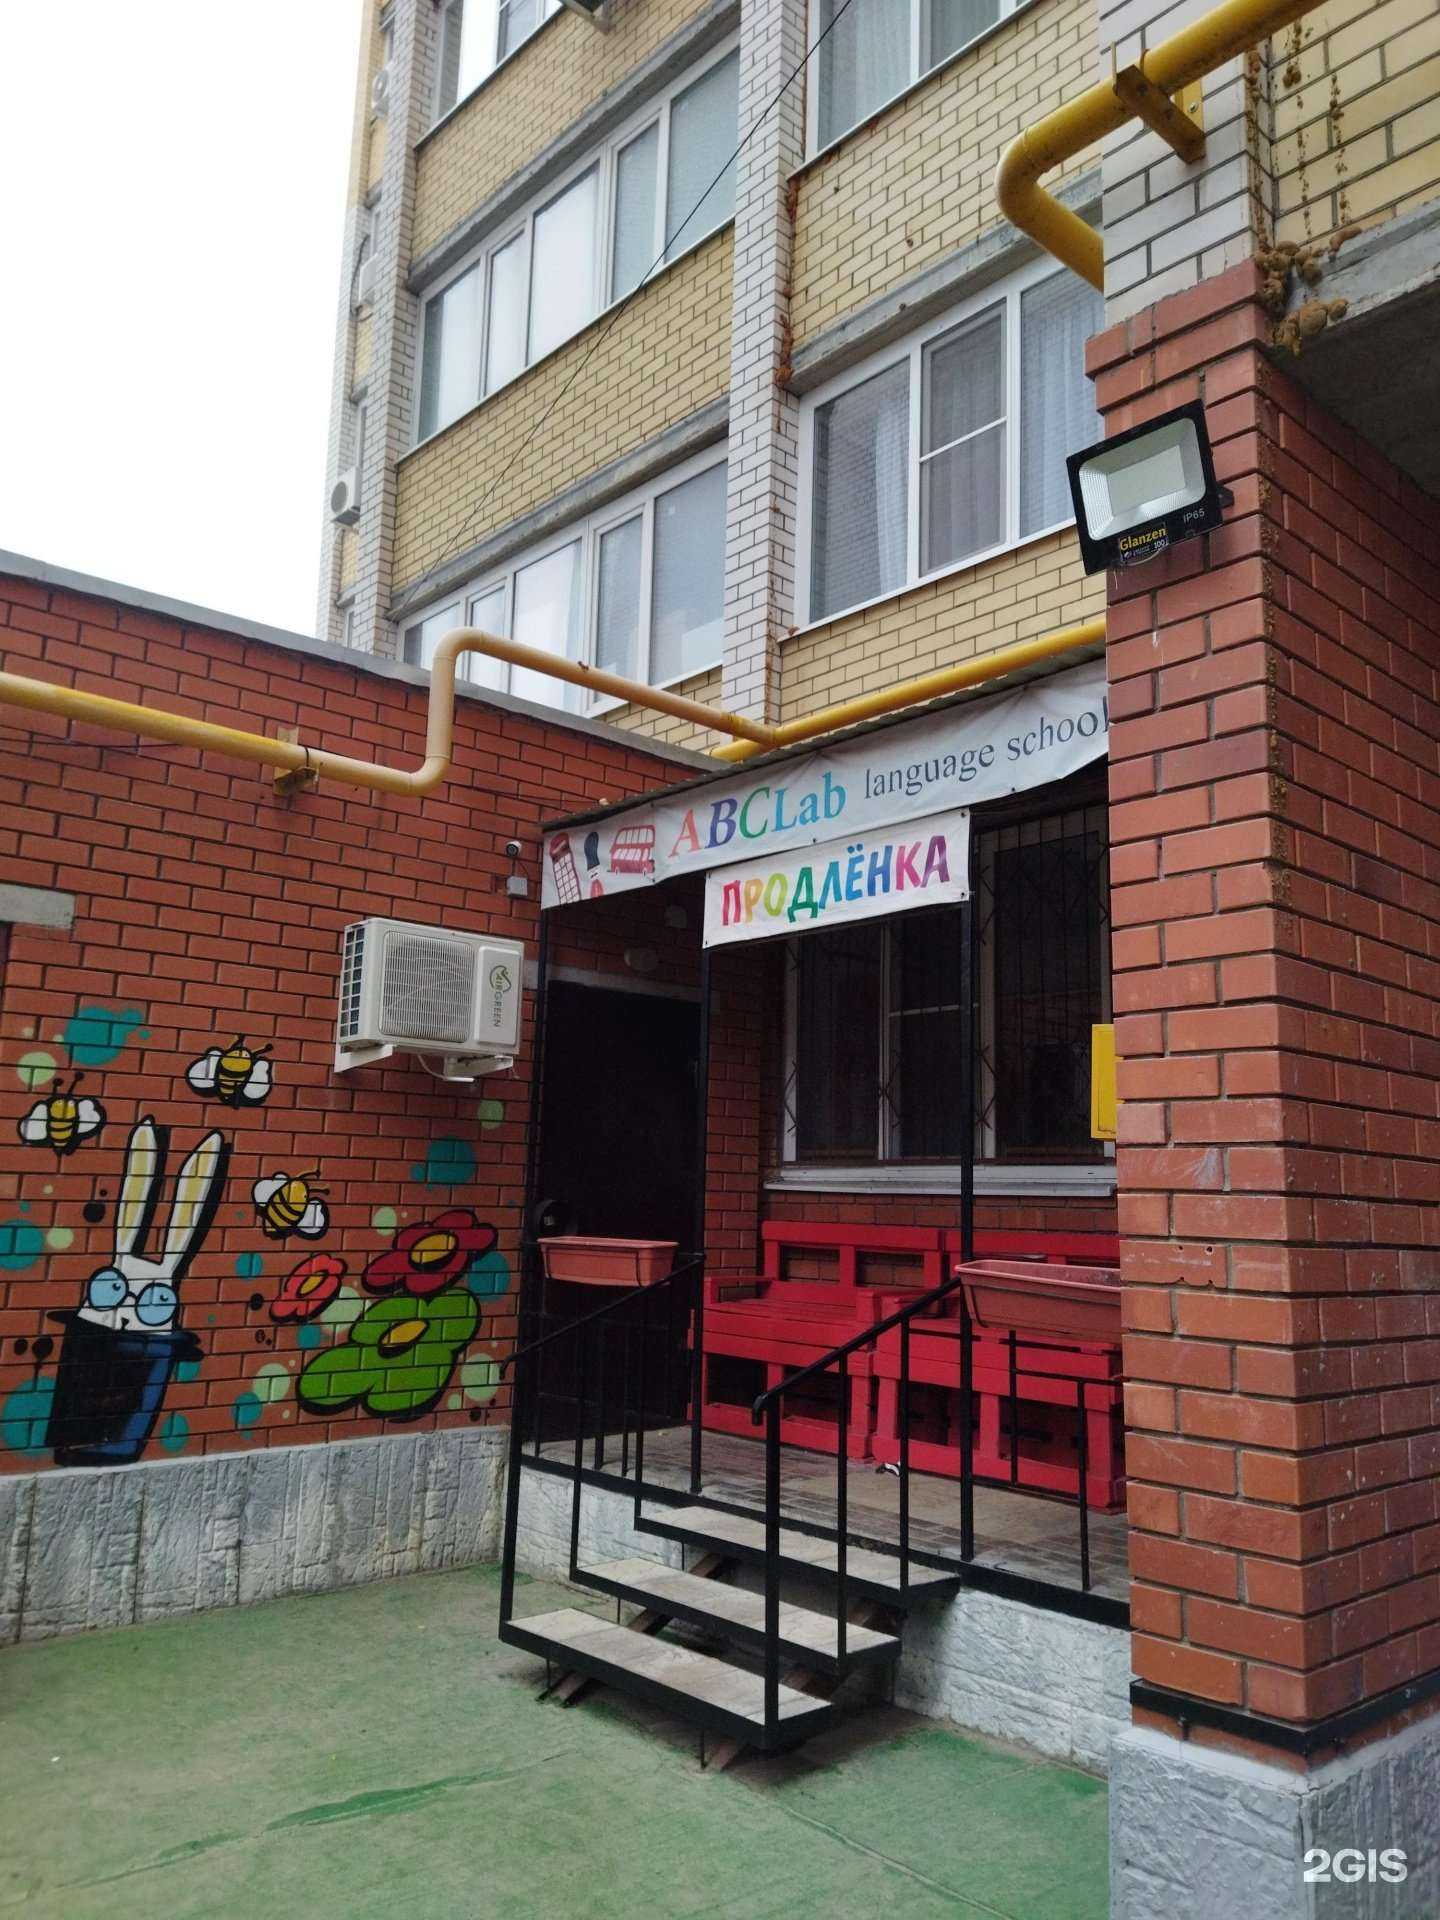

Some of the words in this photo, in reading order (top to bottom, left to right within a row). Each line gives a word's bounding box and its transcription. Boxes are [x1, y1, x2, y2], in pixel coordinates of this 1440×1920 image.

[1119, 528, 1167, 550] Glanzen
[1183, 508, 1205, 524] IP65
[668, 772, 846, 858] ABCLab
[864, 743, 995, 799] language
[1007, 696, 1108, 762] school
[721, 835, 950, 926] ПРОДЛЁНКА
